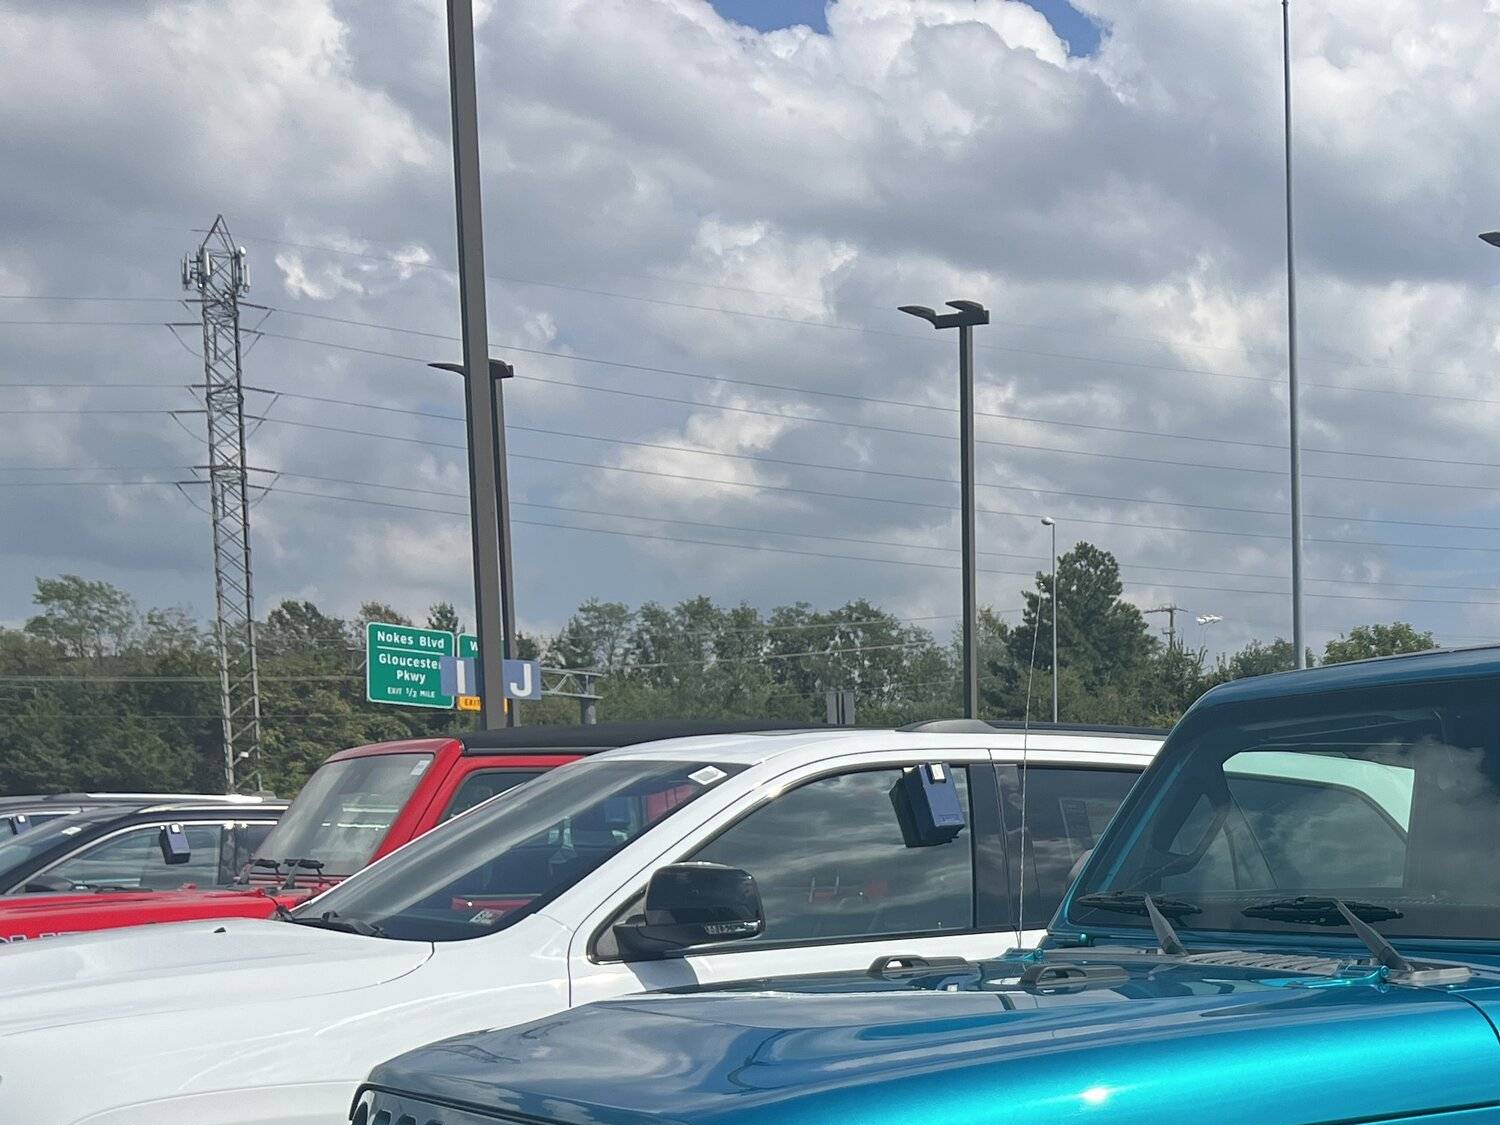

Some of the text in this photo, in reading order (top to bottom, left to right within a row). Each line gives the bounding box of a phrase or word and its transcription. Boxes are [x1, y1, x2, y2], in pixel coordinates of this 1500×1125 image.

[377, 631, 445, 649] Nokes Blvd
[396, 669, 426, 685] Pkwy
[456, 660, 466, 694] I
[510, 663, 532, 697] J
[387, 687, 402, 695] EXIT
[420, 690, 435, 698] MILE
